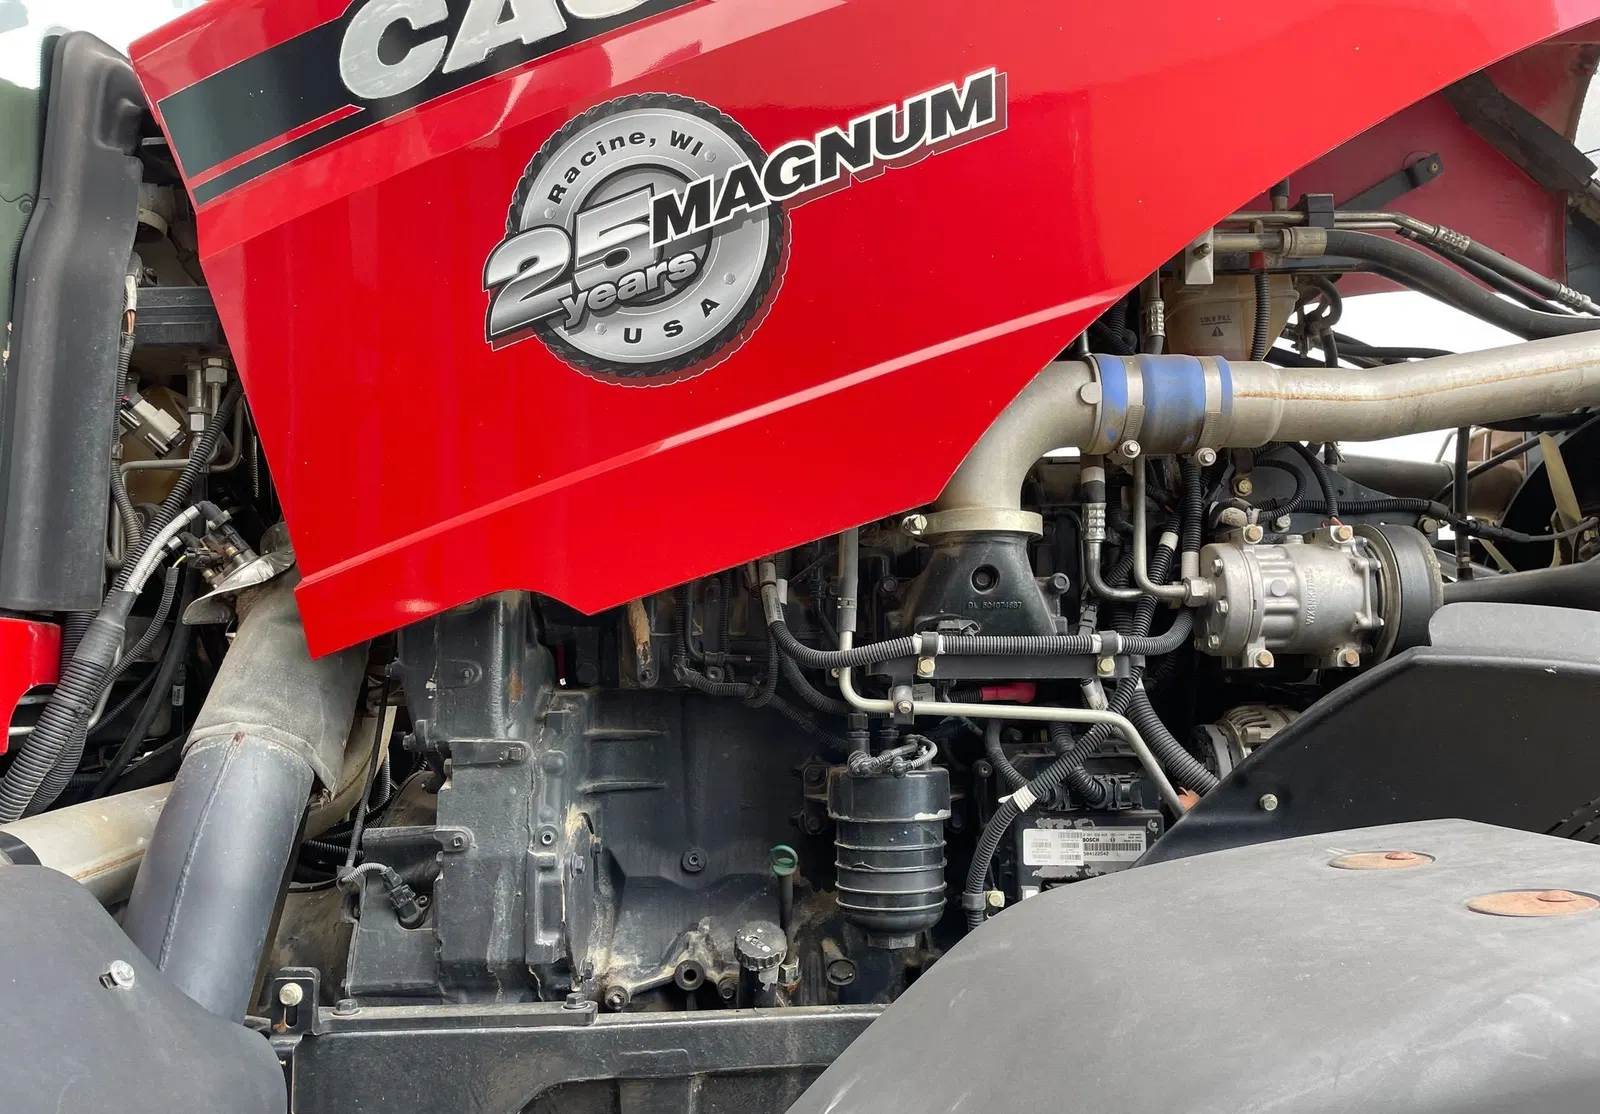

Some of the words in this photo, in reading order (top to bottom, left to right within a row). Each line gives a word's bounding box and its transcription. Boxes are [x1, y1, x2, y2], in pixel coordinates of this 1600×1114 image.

[547, 131, 656, 205] Racine,
[670, 130, 704, 157] WI
[650, 67, 997, 248] MAGNUM
[484, 183, 660, 341] 25
[558, 251, 699, 329] years
